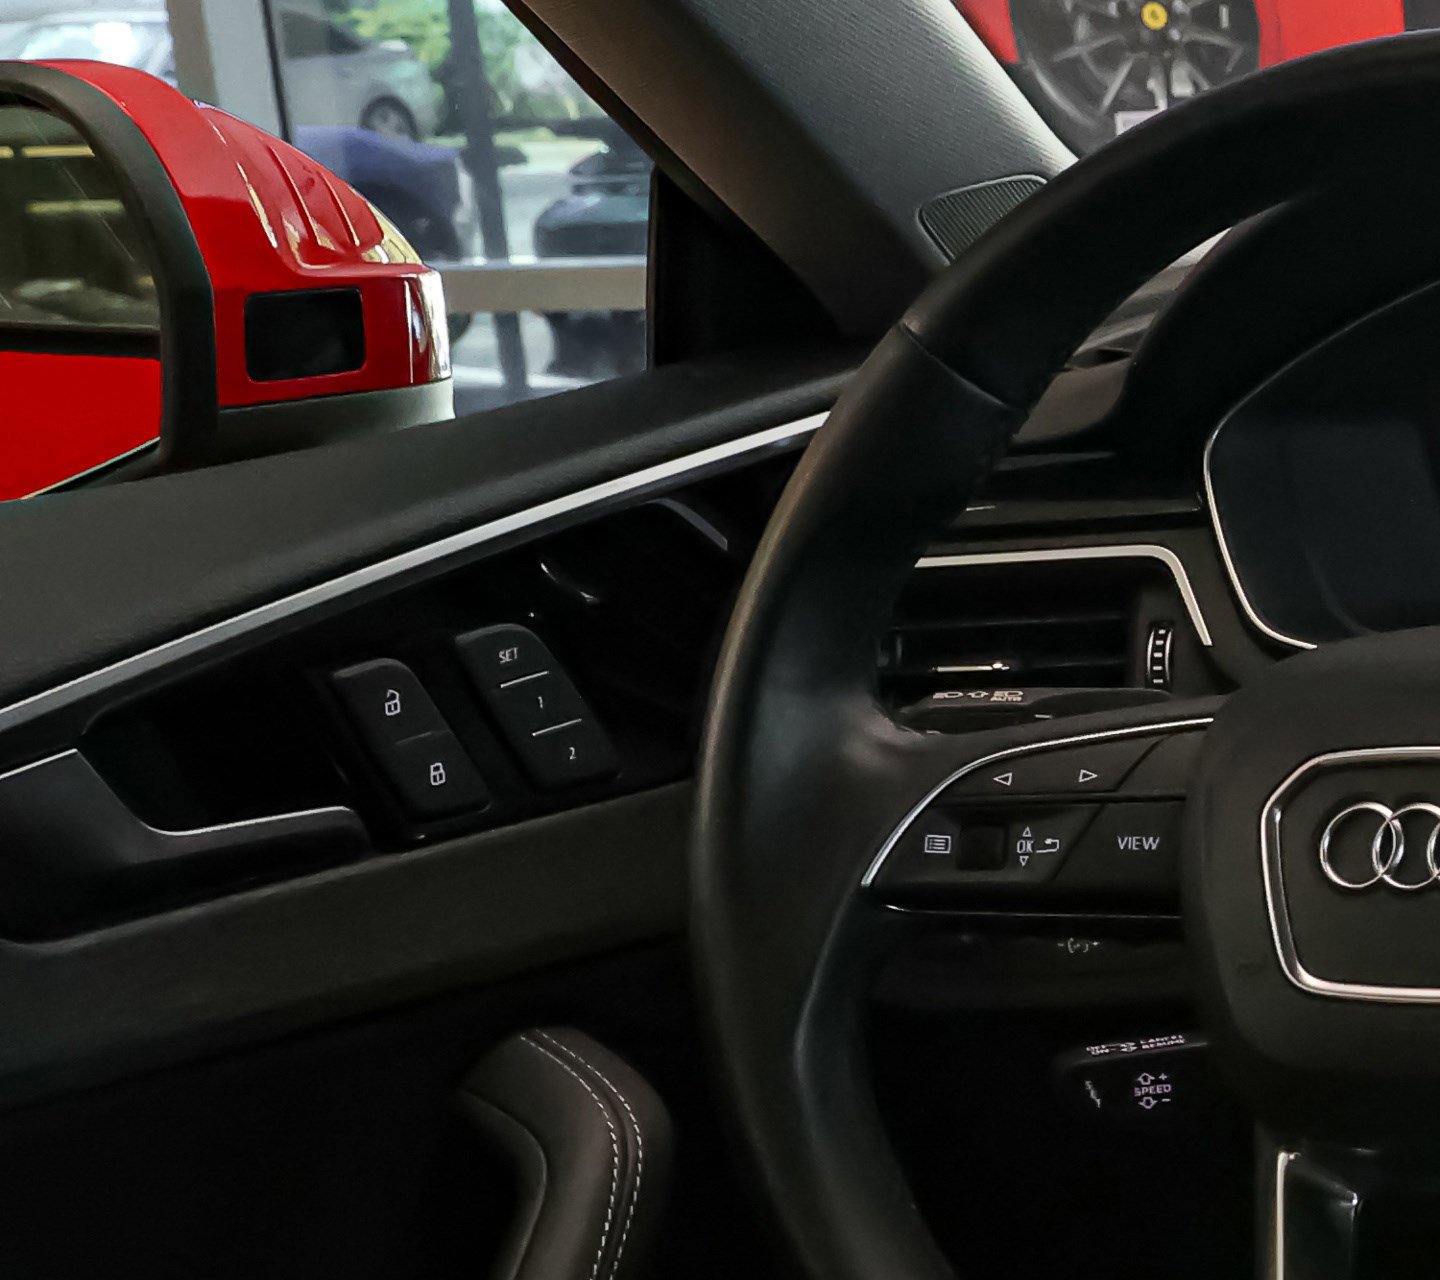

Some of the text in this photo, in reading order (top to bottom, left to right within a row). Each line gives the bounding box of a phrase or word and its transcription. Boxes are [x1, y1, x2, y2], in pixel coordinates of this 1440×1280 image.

[499, 647, 518, 664] SET
[538, 696, 544, 708] 1
[569, 746, 576, 760] 2
[1017, 840, 1033, 854] OK
[1117, 836, 1160, 850] VIEW
[1134, 1084, 1171, 1097] SPEED
